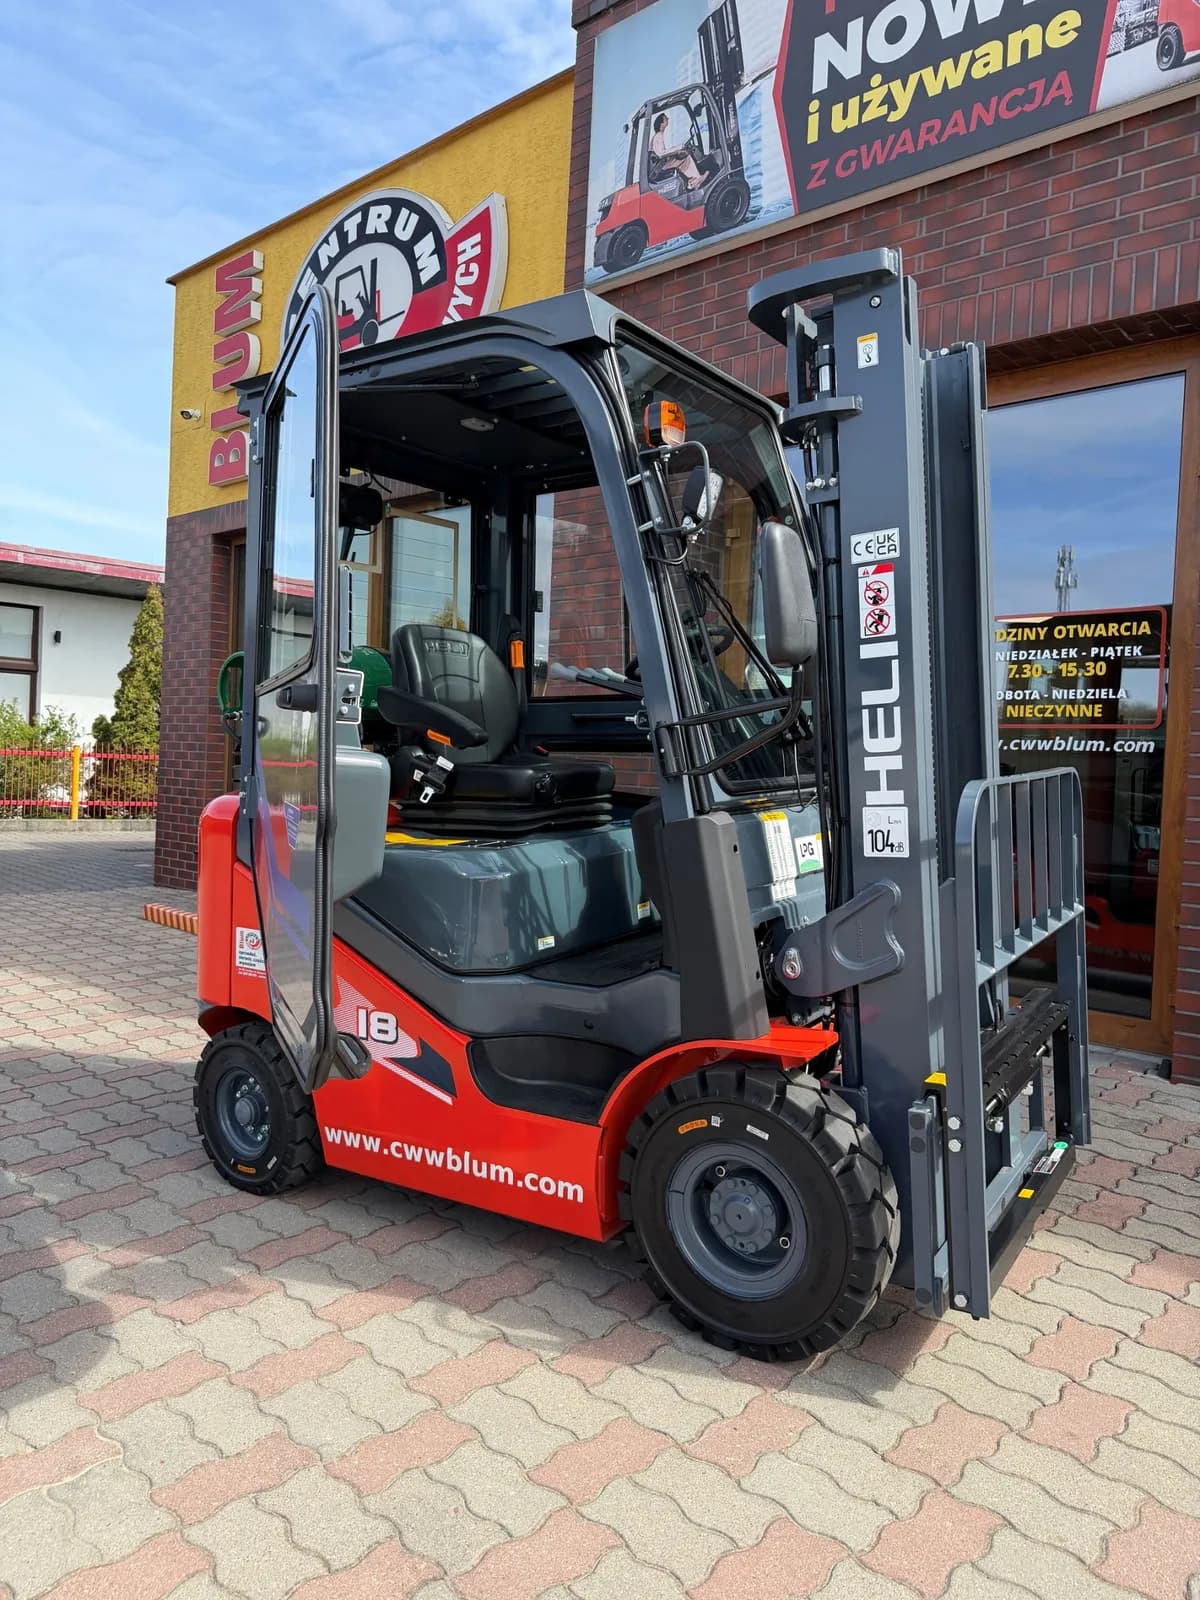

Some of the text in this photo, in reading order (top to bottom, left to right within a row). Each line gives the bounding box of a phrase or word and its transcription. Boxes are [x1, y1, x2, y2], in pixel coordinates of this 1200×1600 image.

[812, 0, 1043, 94] NOW
[806, 99, 820, 144] i
[831, 9, 1083, 134] używane
[806, 70, 1074, 191] Z GWARANCJĄ
[288, 204, 441, 335] ENTRUM
[853, 539, 874, 556] CE
[876, 532, 896, 545] UK
[876, 544, 897, 555] CA
[1053, 620, 1152, 640] OTWARCIA
[995, 647, 1079, 661] NIEDZIAŁEK
[1090, 645, 1143, 660] PIĄTEK
[1008, 664, 1042, 679] 7.30
[1059, 661, 1107, 677] 15.30
[1052, 688, 1128, 700] NIEDZIELA
[1006, 704, 1103, 718] NIECZYNNE
[860, 640, 905, 806] HELI
[799, 842, 815, 858] LPG
[867, 829, 895, 853] 104
[357, 1007, 398, 1045] 18
[324, 1126, 584, 1204] www.cwwblum.com
